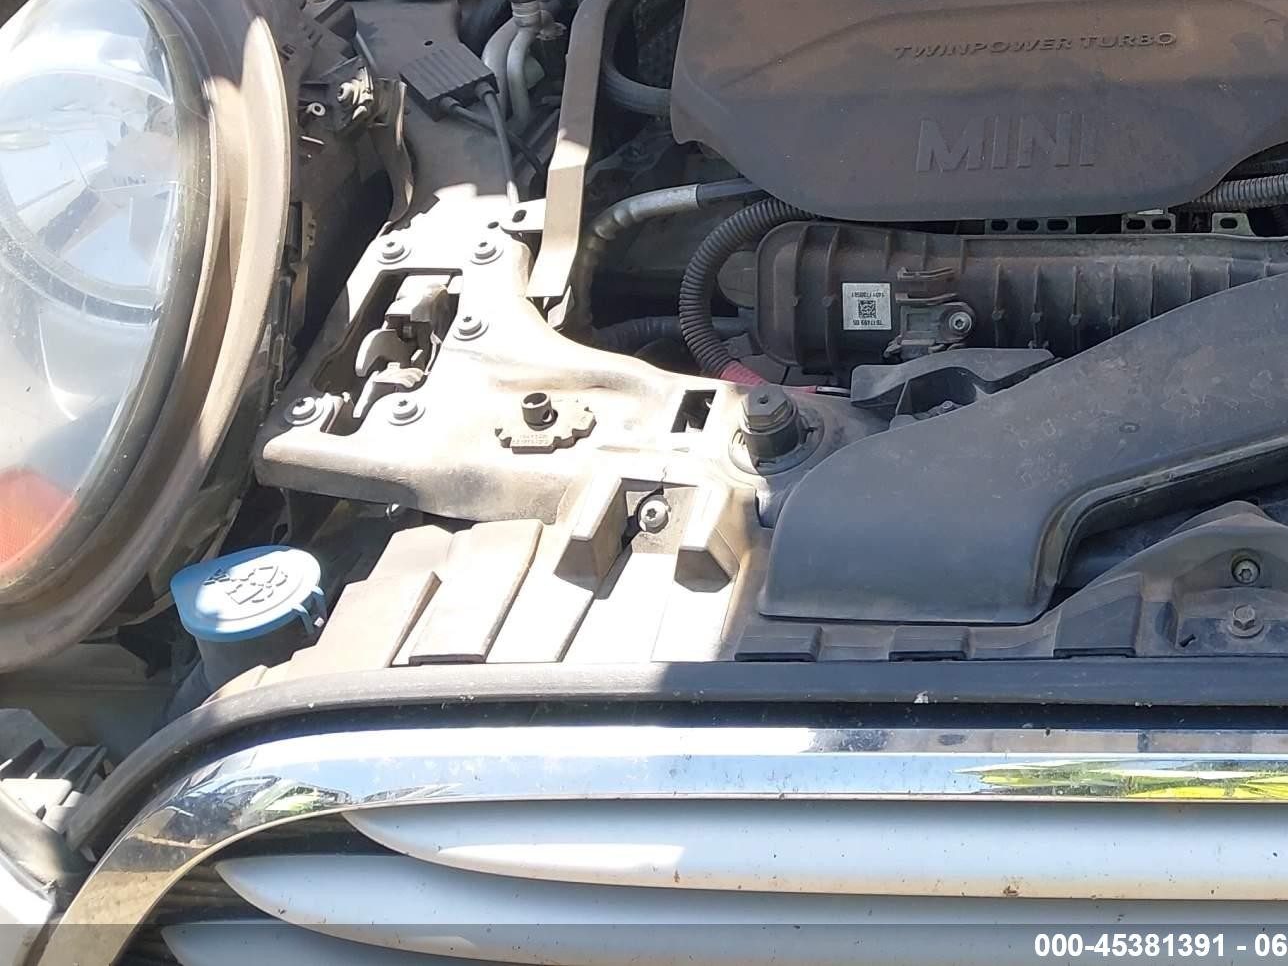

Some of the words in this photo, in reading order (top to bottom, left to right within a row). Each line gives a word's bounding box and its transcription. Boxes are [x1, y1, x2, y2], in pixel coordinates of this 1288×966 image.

[894, 37, 1073, 59] TWINPOWER
[1079, 32, 1177, 50] TURBO
[916, 113, 1099, 173] MINI
